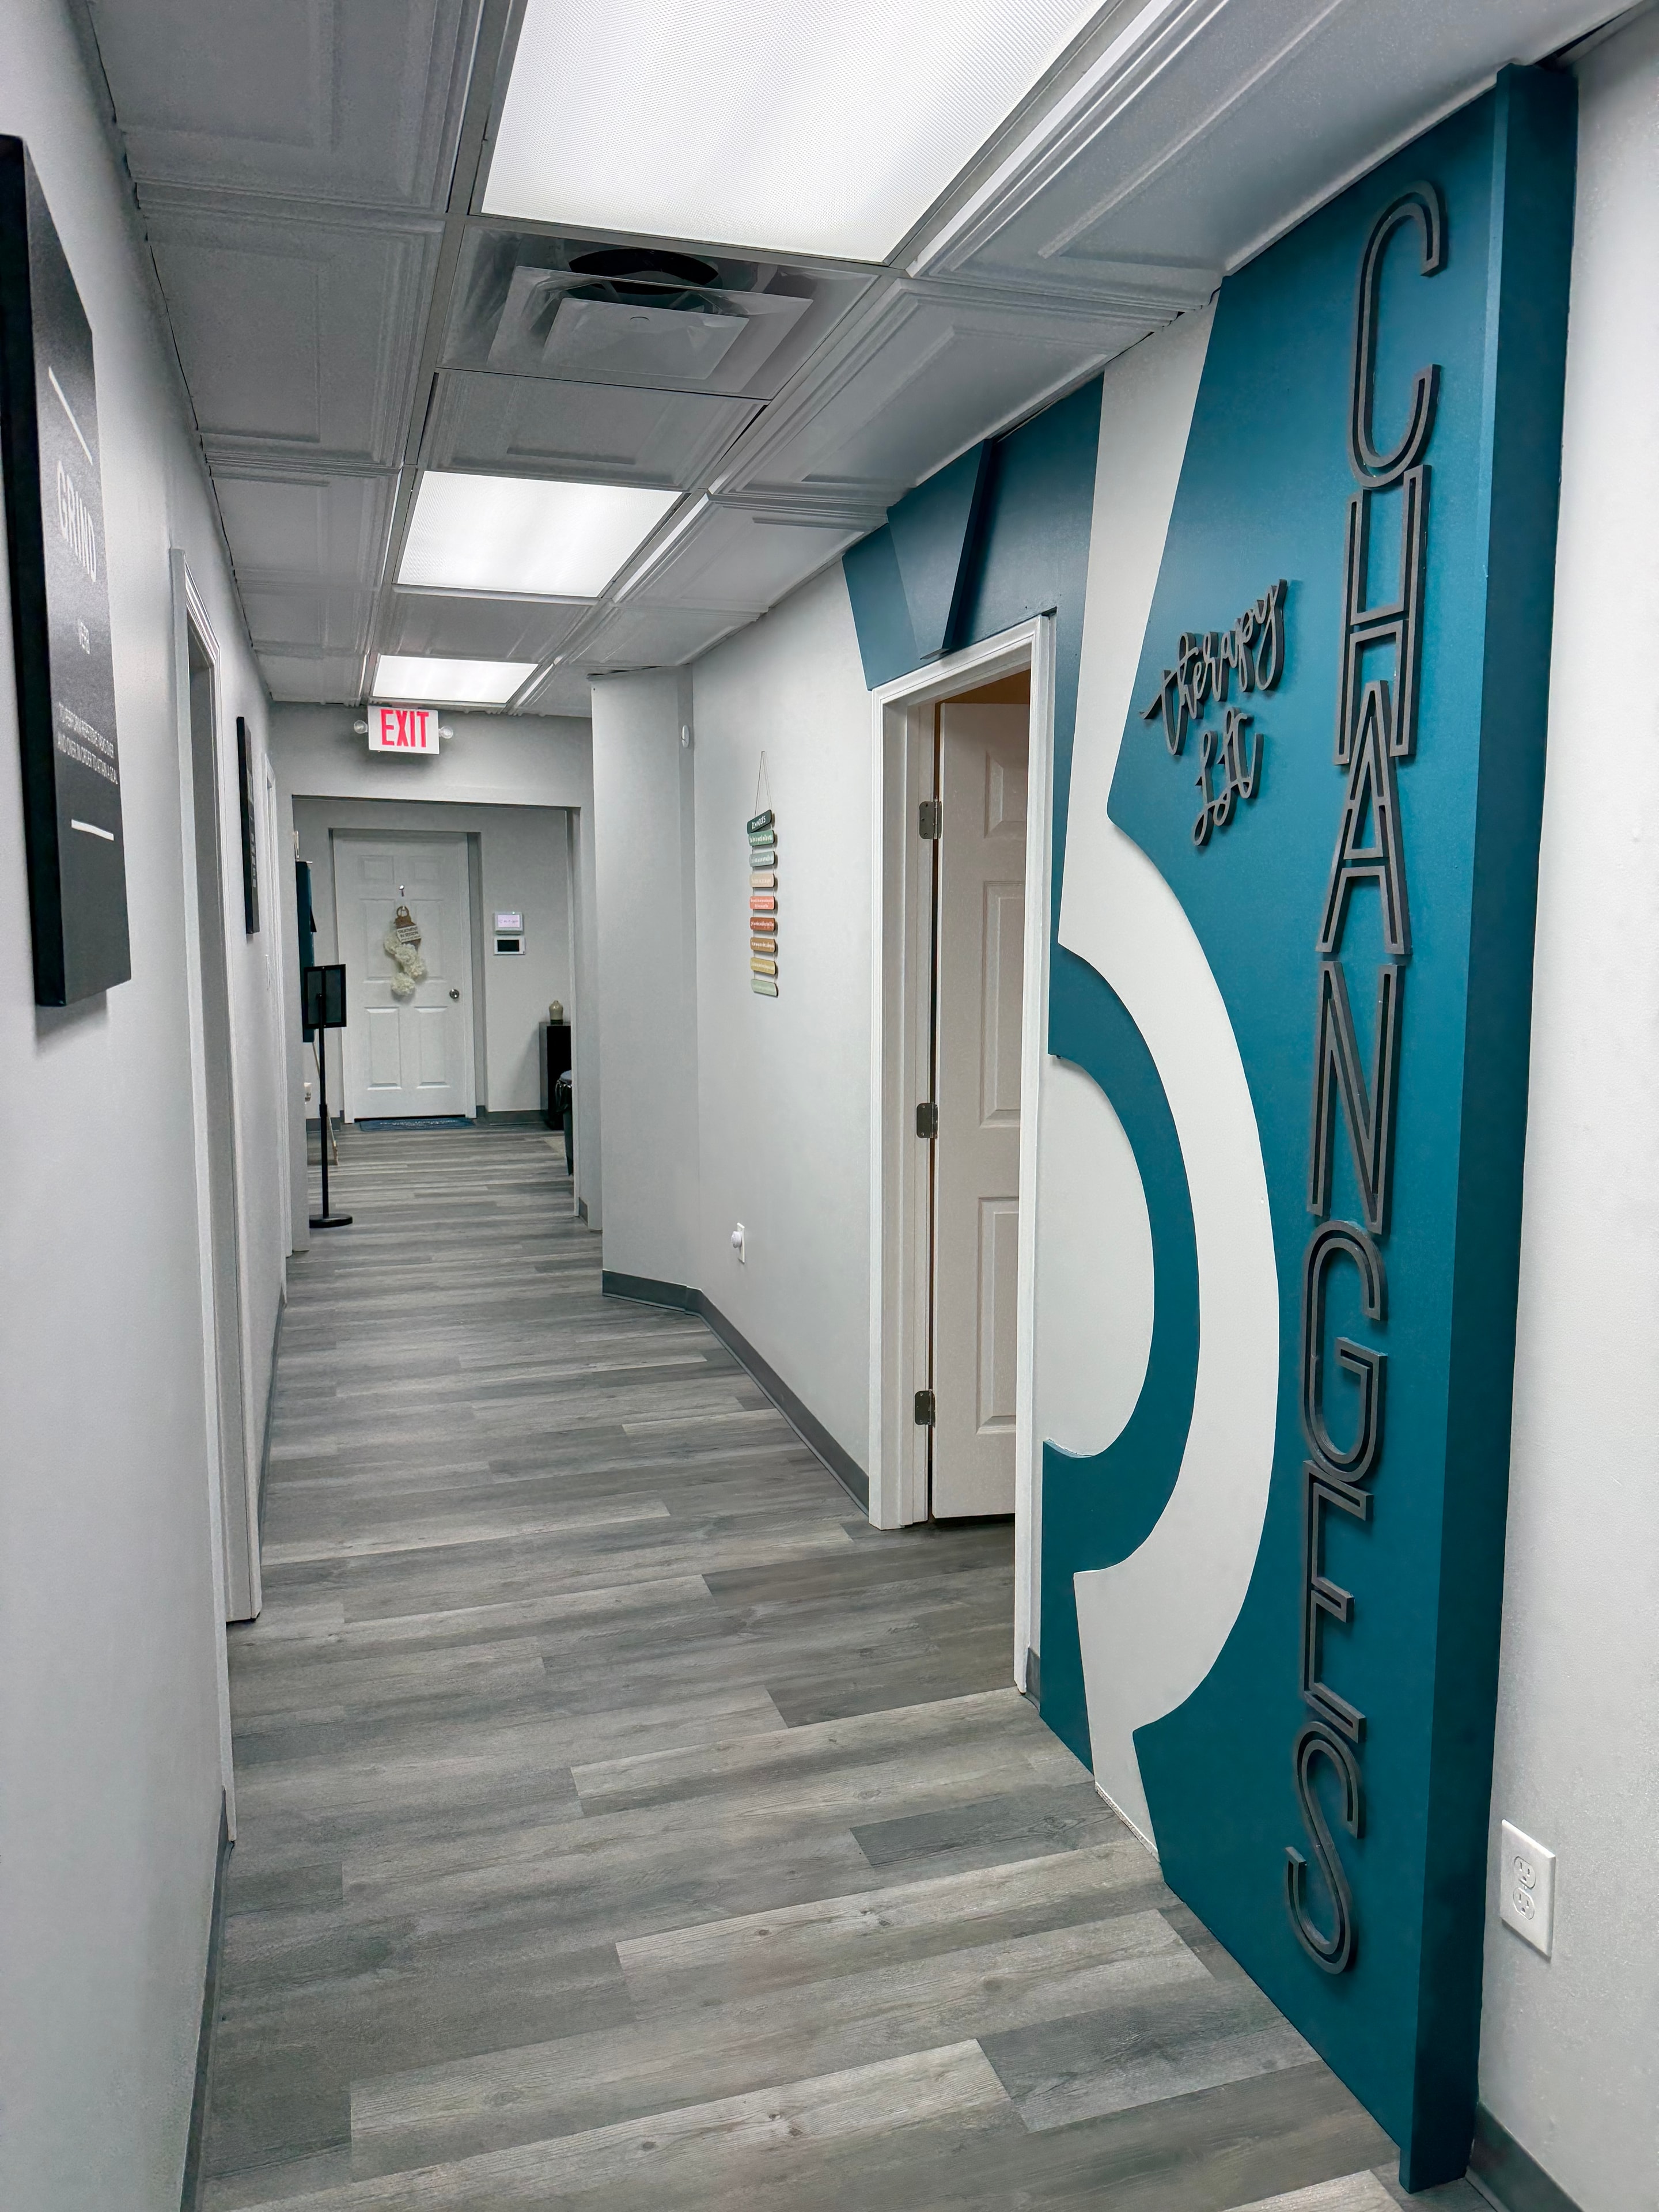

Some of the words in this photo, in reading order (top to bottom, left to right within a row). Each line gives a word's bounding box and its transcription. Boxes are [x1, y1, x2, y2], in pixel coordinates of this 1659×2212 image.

[57, 460, 97, 583] GRIND
[380, 709, 429, 748] EXIT
[1283, 180, 1448, 1976] CHANGES
